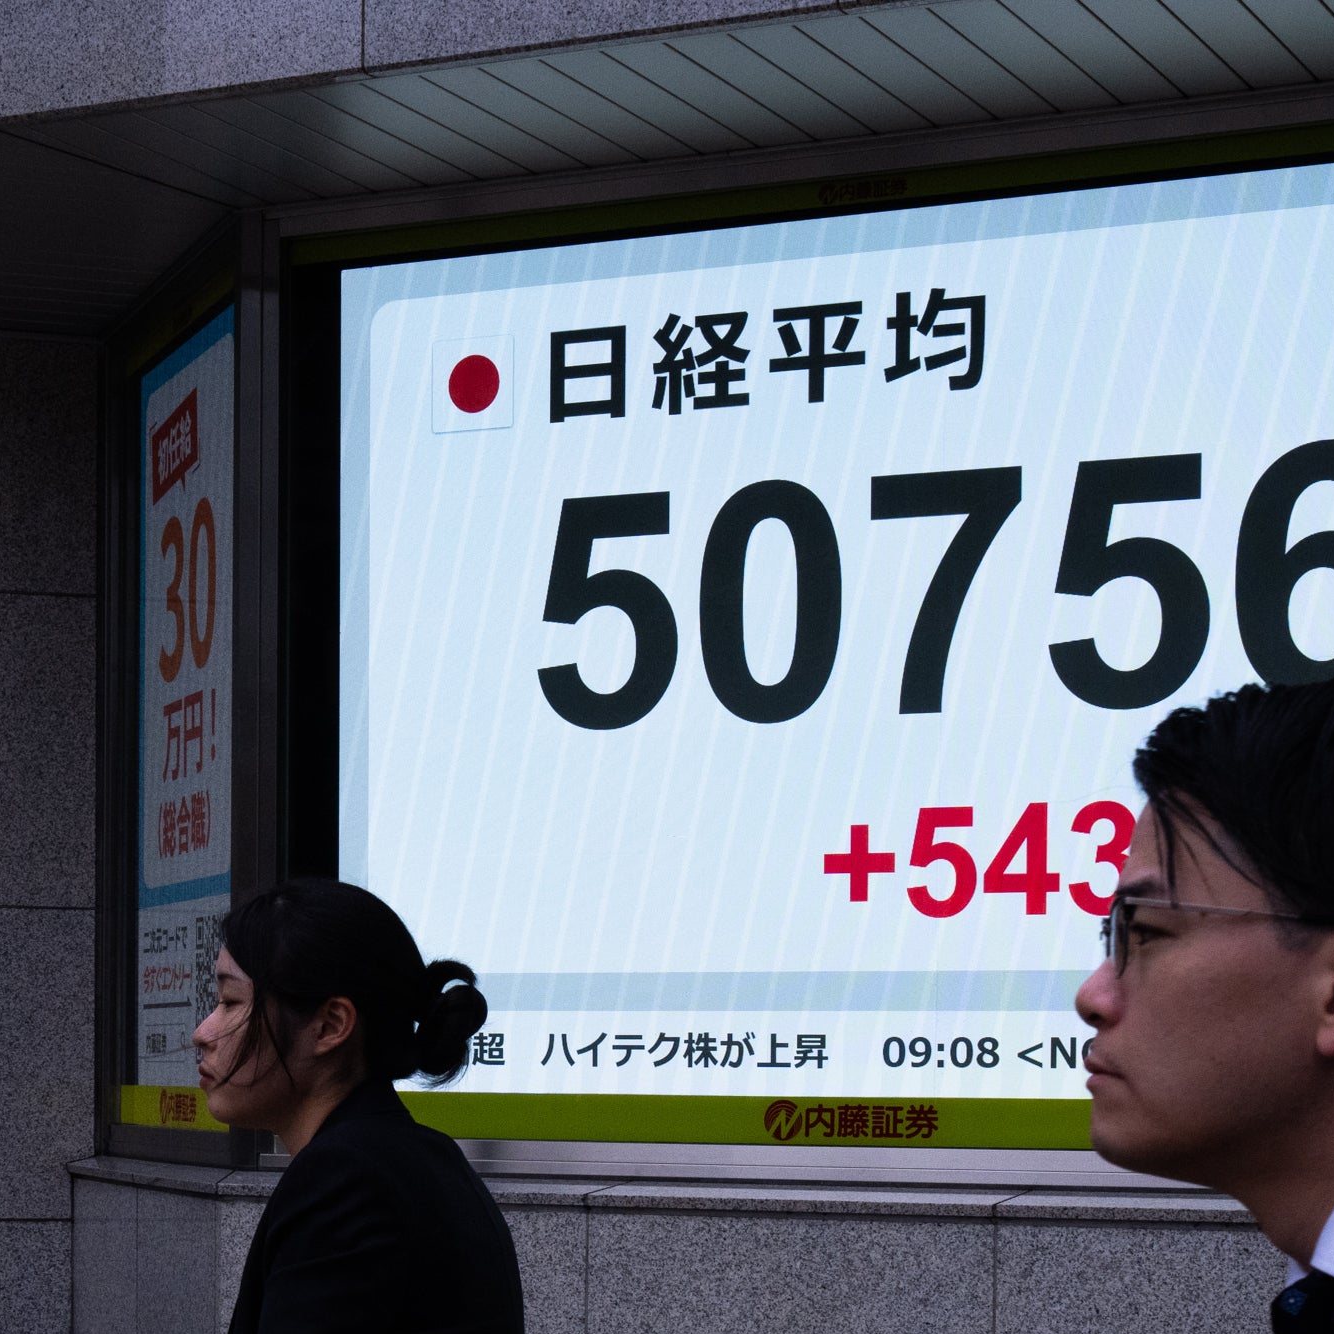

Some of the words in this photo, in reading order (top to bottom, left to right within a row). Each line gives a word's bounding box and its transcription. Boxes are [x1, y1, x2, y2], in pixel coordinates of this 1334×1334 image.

[550, 288, 986, 423] 日経平均
[158, 410, 192, 482] 初任給
[158, 496, 216, 683] 30
[162, 688, 216, 783] 万円!
[472, 1032, 506, 1066] 超
[540, 1032, 829, 1069] ハイテク株が上昇
[882, 1036, 1000, 1068] 09:08
[802, 1103, 940, 1141] 内藤証券
